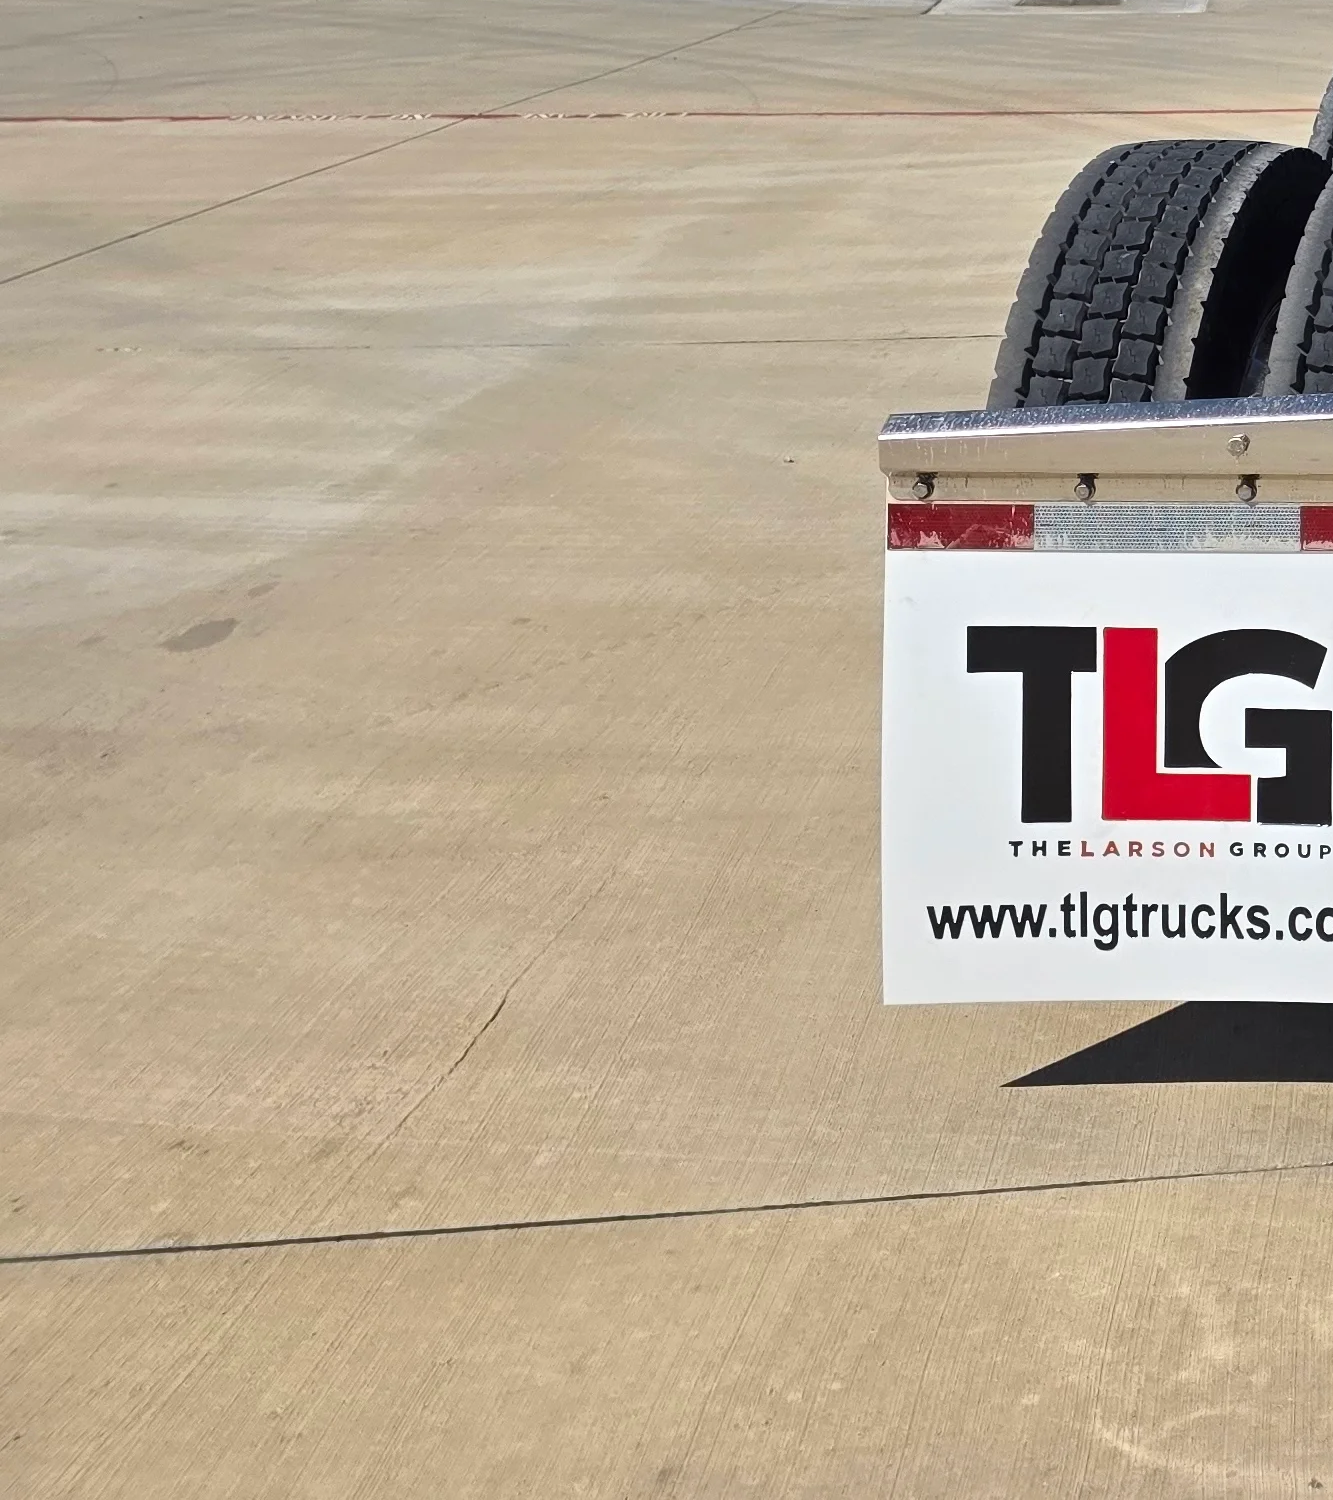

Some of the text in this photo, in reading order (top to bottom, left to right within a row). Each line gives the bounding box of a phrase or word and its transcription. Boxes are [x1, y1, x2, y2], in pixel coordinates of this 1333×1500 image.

[966, 625, 1333, 828] TLG
[1008, 839, 1333, 860] THE LARSON GROUP
